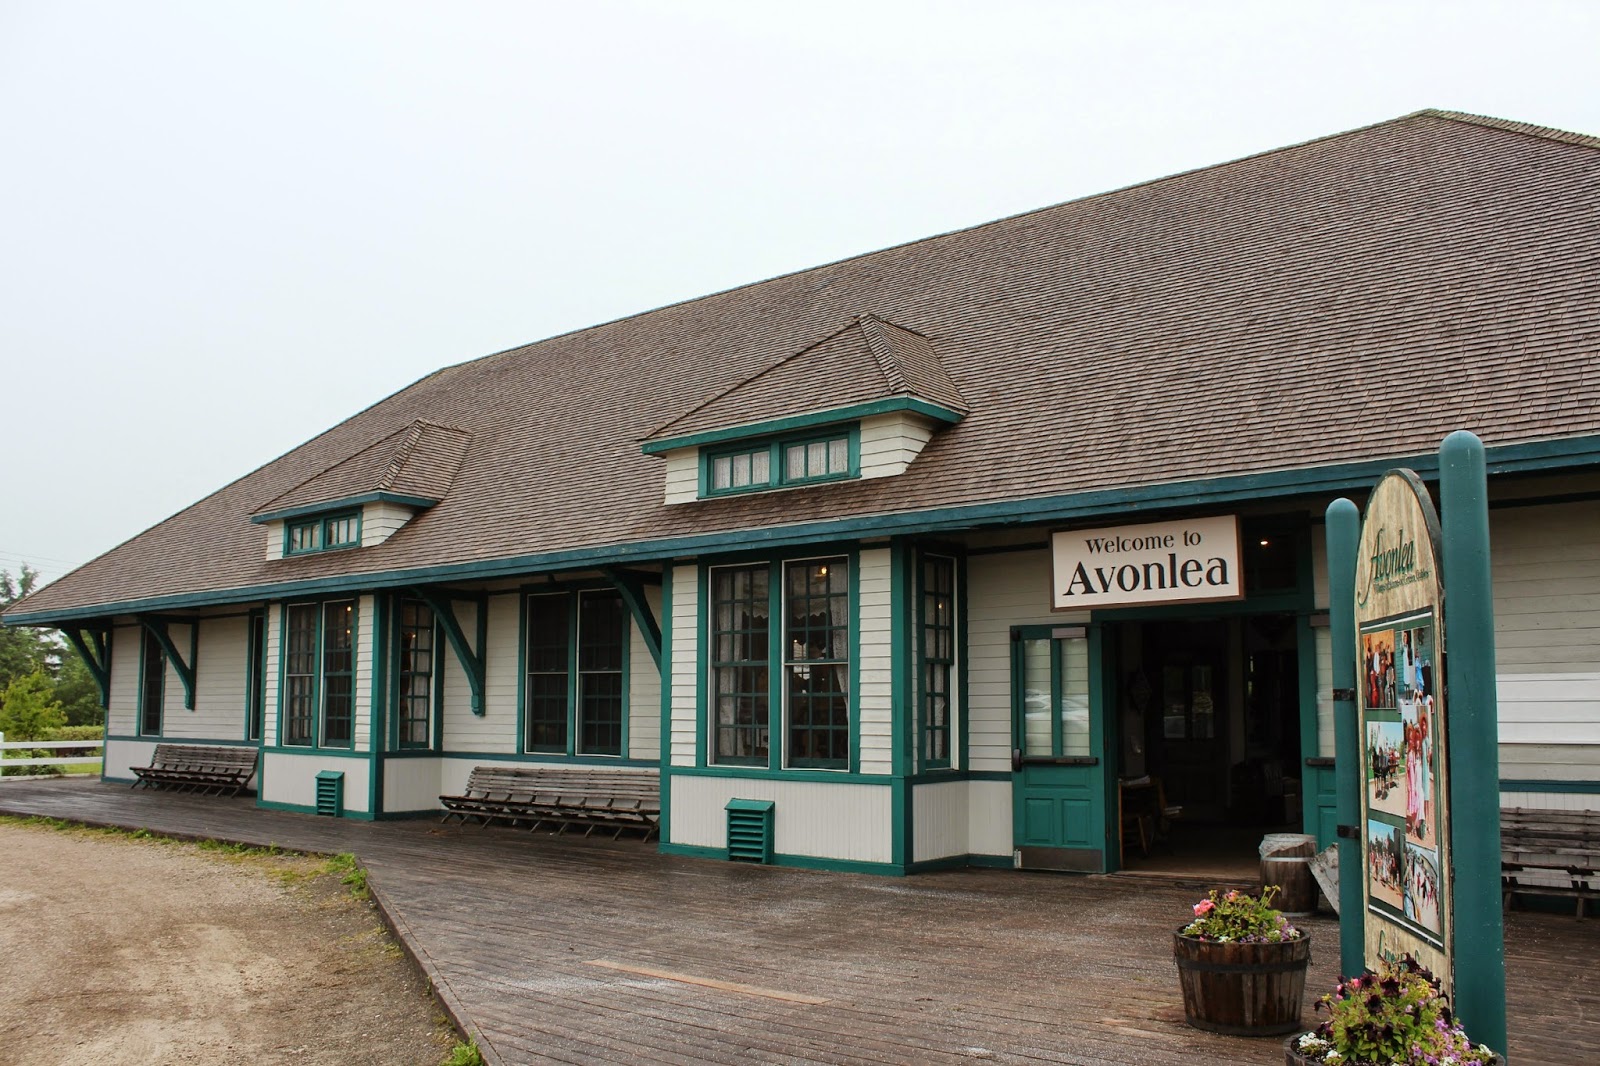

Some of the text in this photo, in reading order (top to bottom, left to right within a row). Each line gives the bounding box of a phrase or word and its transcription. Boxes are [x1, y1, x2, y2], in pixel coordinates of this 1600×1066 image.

[1085, 530, 1201, 554] Welcome to
[1062, 553, 1229, 596] Avonlea
[1358, 527, 1414, 607] Avonlea
